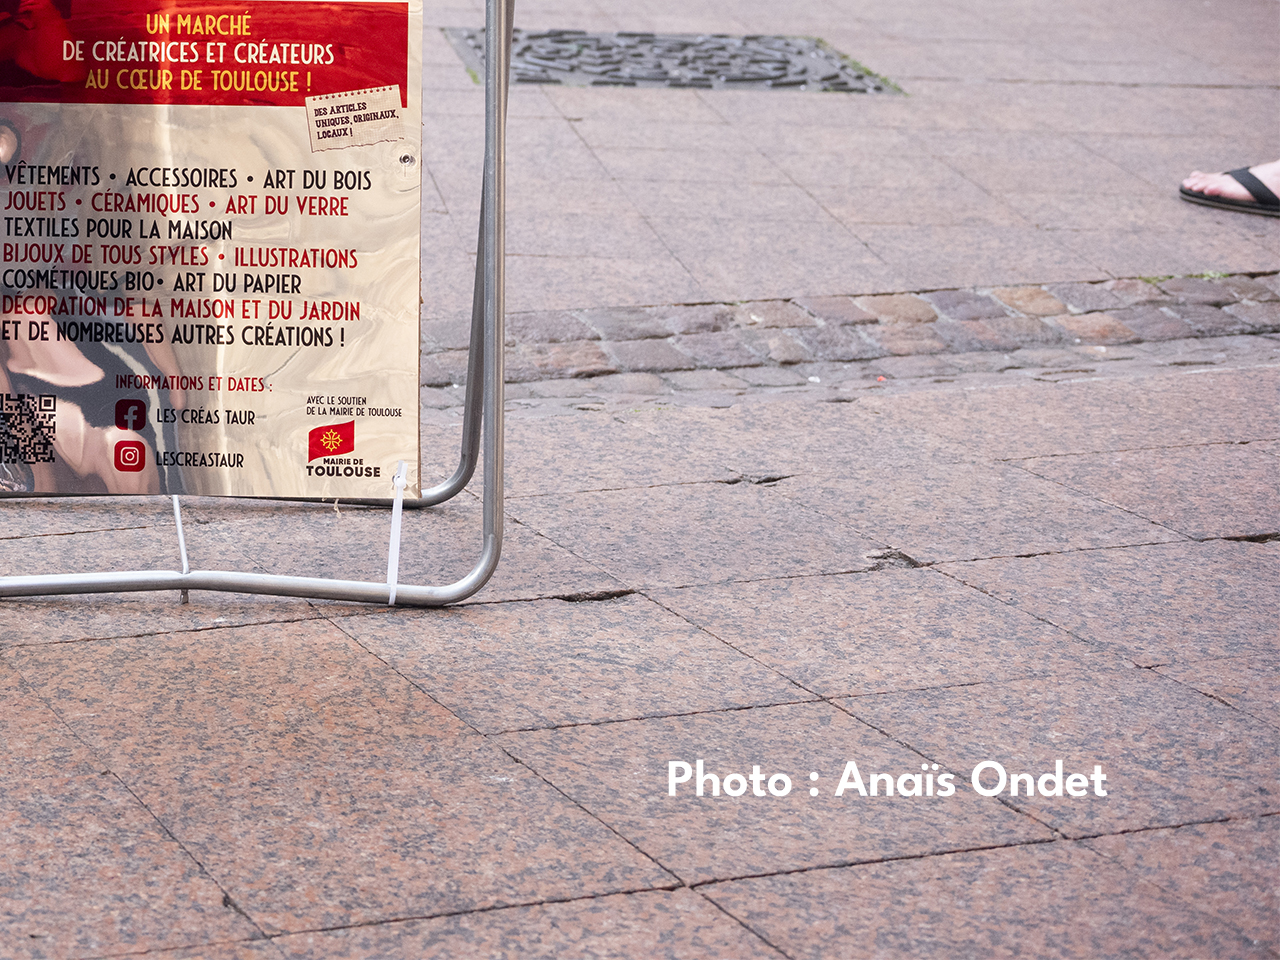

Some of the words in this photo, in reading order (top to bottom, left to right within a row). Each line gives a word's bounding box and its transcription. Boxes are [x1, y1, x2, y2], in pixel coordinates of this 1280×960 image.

[146, 13, 170, 34] UN
[177, 10, 252, 36] MARCHÉ
[62, 40, 85, 61] DE
[92, 37, 199, 63] CRÉATRICES
[206, 42, 226, 63] ET
[234, 39, 335, 64] CRÉATEURS
[85, 69, 108, 89] AU
[116, 69, 173, 90] CŒUR
[181, 70, 203, 91] DE
[211, 70, 299, 92] TOULOUSE
[314, 107, 328, 117] DES
[329, 102, 367, 115] ARTICLES
[315, 116, 353, 128] UNIQUES,
[353, 109, 399, 123] ORIGINAUX,
[4, 160, 100, 186] VÊTEMENTS
[125, 167, 237, 188] ACCESSOIRES
[263, 169, 296, 189] ART
[303, 170, 326, 190] DU
[333, 170, 372, 190] BOIS
[4, 190, 66, 211] JOUETS
[91, 188, 200, 217] CÉRAMIQUES
[225, 195, 258, 214] ART
[265, 195, 289, 215] DU
[296, 196, 349, 216] VERRE
[4, 217, 79, 237] TEXTILES
[86, 218, 132, 238] POUR
[139, 219, 160, 239] LA
[168, 219, 232, 240] MAISON
[3, 243, 65, 263] BIJOUX
[72, 244, 93, 264] DE
[100, 244, 142, 265] TOUS
[149, 245, 209, 266] STYLES
[235, 247, 358, 269] ILLUSTRATIONS
[2, 265, 119, 293] COSMÉTIQUES
[173, 272, 206, 292] ART
[213, 272, 237, 293] DU
[243, 273, 302, 294] PAPIER
[2, 290, 107, 316] DÉCORATION
[114, 297, 135, 317] DE
[142, 297, 163, 317] LA
[170, 298, 235, 319] MAISON
[242, 299, 261, 319] ET
[268, 300, 292, 320] DU
[299, 300, 360, 321] JARDIN
[2, 320, 21, 340] ET
[28, 321, 49, 341] DE
[57, 321, 164, 344] NOMBREUSES
[171, 324, 235, 345] AUTRES
[241, 322, 333, 347] CRÉATIONS
[115, 374, 204, 391] INFORMATIONS
[208, 376, 222, 391] ET
[228, 377, 265, 392] DATES
[306, 396, 324, 405] AVEC
[327, 396, 335, 405] LE
[337, 396, 367, 405] SOUTIEN
[306, 406, 315, 415] DE
[318, 407, 327, 416] LA
[329, 407, 353, 416] MAIRIE
[356, 407, 365, 416] DE
[368, 408, 402, 417] TOULOUSE
[156, 408, 177, 423] LES
[181, 406, 220, 424] CRÉAS
[225, 410, 255, 425] TAUR
[155, 451, 244, 468] LESCREASTAUR
[306, 465, 381, 477] TOULOUSE
